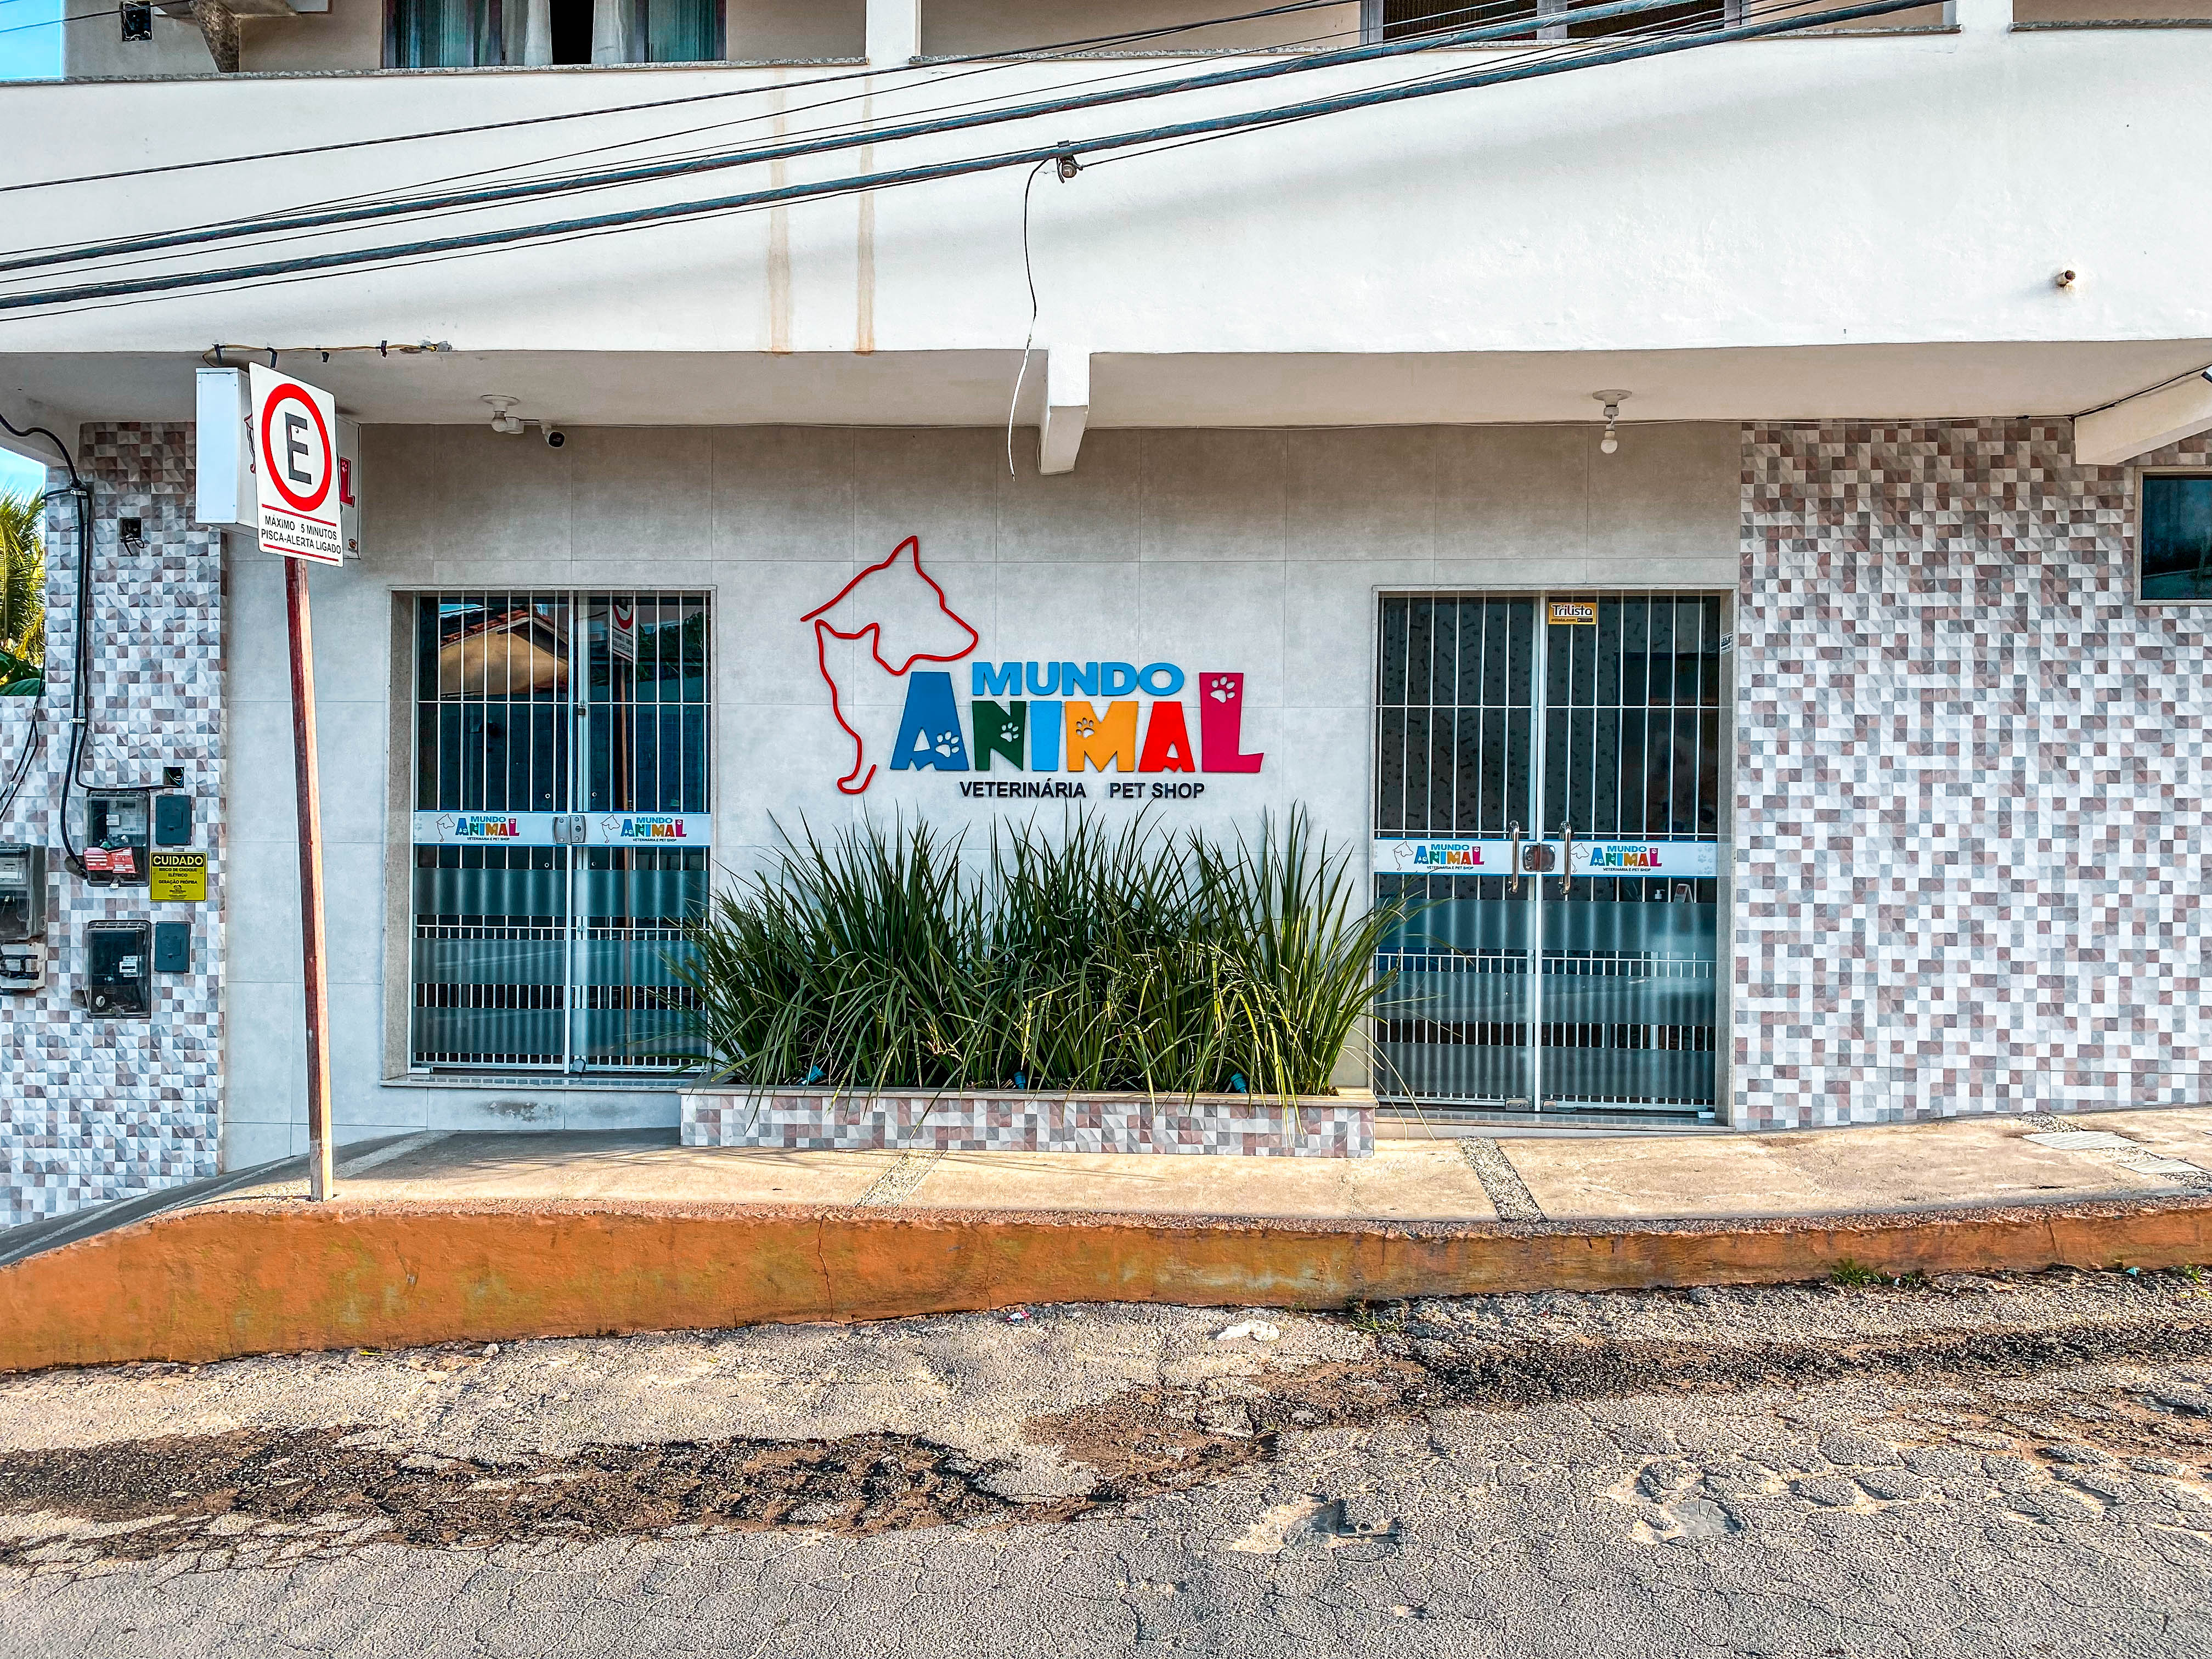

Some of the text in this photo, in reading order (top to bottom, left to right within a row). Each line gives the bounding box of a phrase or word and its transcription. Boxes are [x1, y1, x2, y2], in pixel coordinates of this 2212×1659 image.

[284, 411, 312, 485] E
[264, 515, 337, 540] MÁXIMO 5 MINUTOS
[261, 528, 341, 554] PISCA-ALERTA LIGADO
[1551, 605, 1593, 616] Trilista
[972, 662, 1185, 696] MUNDO
[889, 672, 1264, 772] ANIMAL
[959, 778, 1205, 799] VETERINÁRIA PET SHOP
[455, 817, 520, 837] ANIMAL
[620, 819, 687, 838] ANIMAL
[153, 856, 203, 865] CUIDADO
[1414, 845, 1485, 865] ANIMAL
[1589, 847, 1663, 867] ANIMAL
